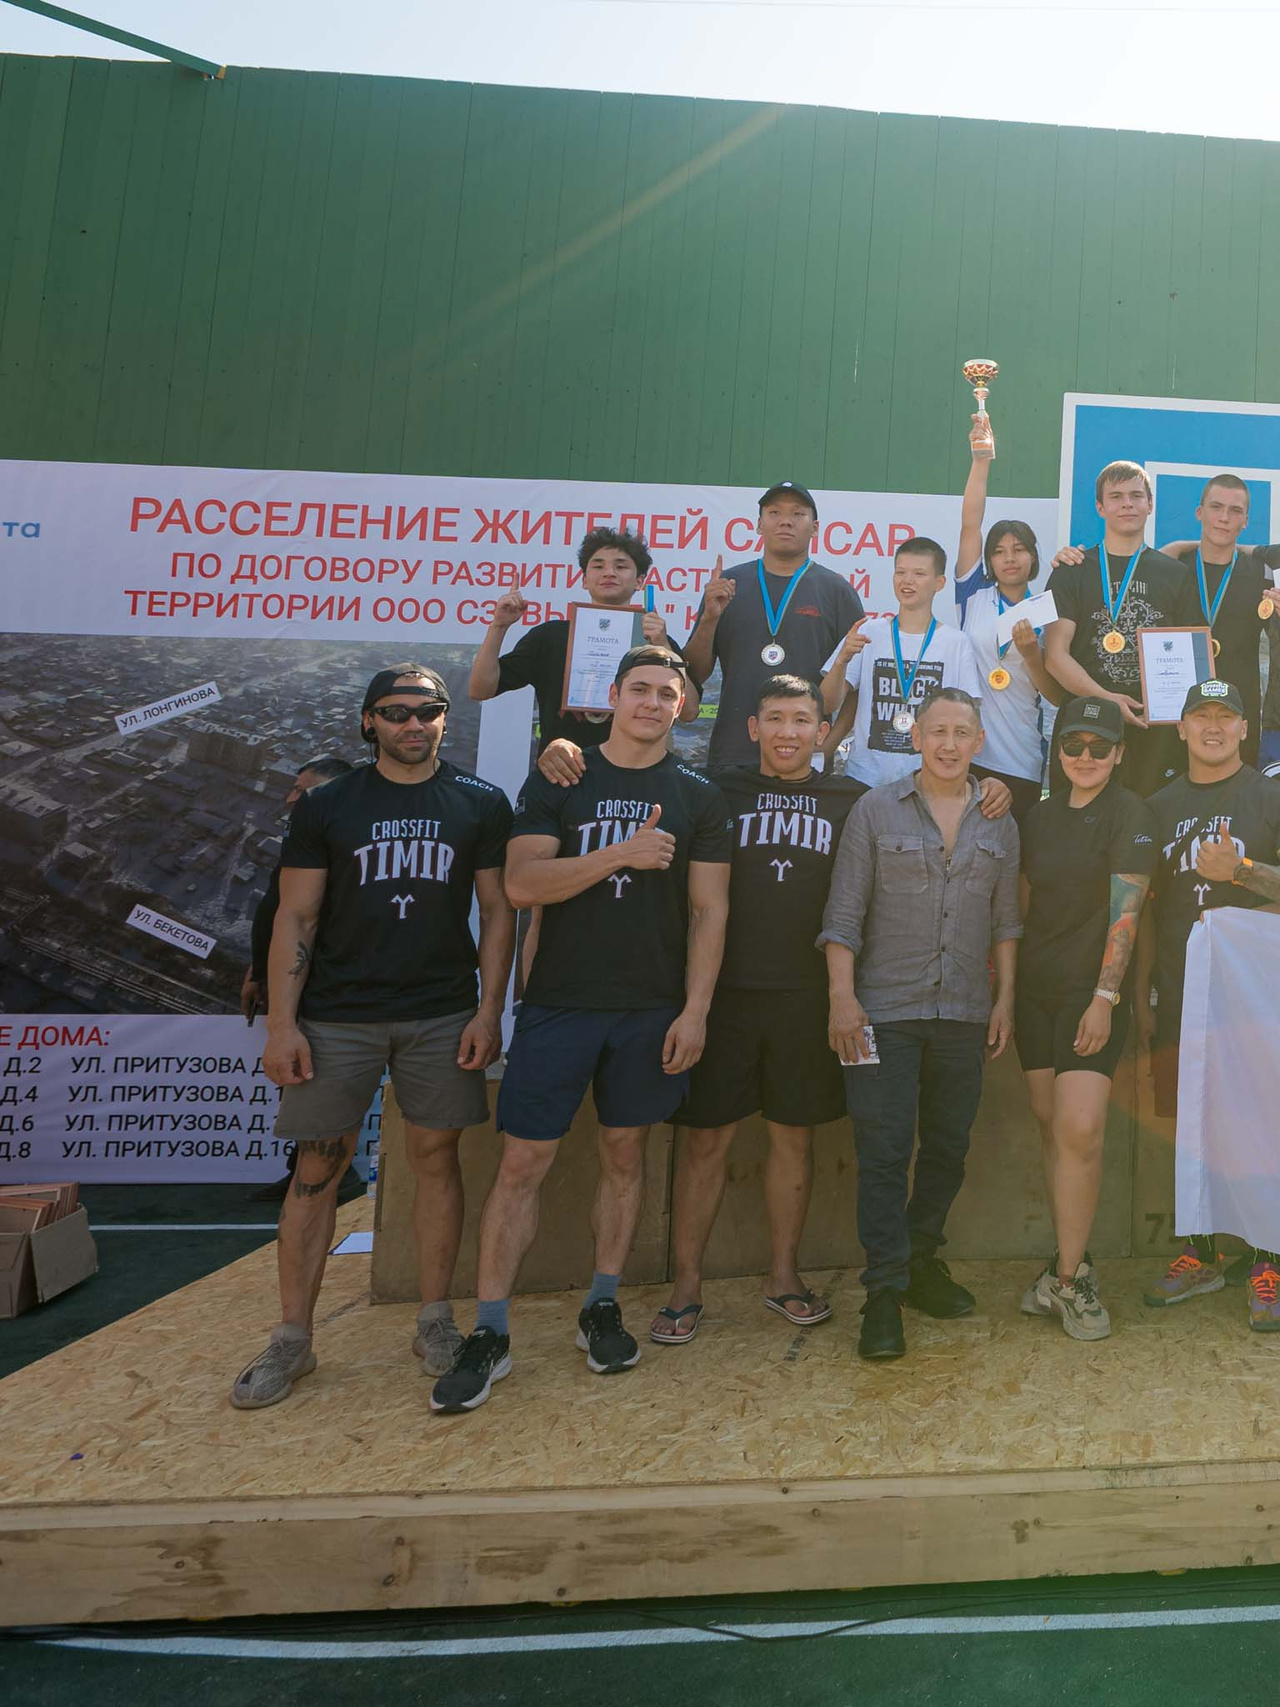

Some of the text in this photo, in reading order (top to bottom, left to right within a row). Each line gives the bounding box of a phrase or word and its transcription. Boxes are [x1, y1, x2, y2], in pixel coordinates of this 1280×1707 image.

[130, 497, 460, 542] РАССЕЛЕНИЕ
[171, 552, 583, 588] ПО ДОГОВОРУ РАЗВИТИ
[124, 590, 361, 621] ТЕРРИТОРИИ
[372, 596, 446, 624] ООО
[120, 687, 216, 728] УЛ. ЛОНГИНОВА
[455, 775, 494, 792] COACH
[676, 763, 710, 785] COACH
[757, 793, 817, 815] CROSSFIT
[372, 818, 441, 841] CROSSFIT
[739, 811, 833, 855] TIMIR
[354, 840, 455, 886] TIMIR
[134, 909, 209, 951] УЛ. БЕКЕТОВА
[17, 1026, 110, 1051] ДОМА:
[3, 1057, 42, 1077] Д.2
[71, 1057, 106, 1073] УЛ.
[113, 1057, 246, 1073] ПРИТУЗОВА
[0, 1085, 284, 1106] Д.4 УЛ. ПРИТУЗОВА Д.1
[0, 1115, 34, 1135] Д.6
[65, 1115, 100, 1131] УЛ.
[107, 1114, 242, 1131] ПРИТУЗОВА
[0, 1141, 31, 1162] Д.8
[62, 1141, 97, 1158] УЛ.
[104, 1140, 240, 1158] ПРИТУЗОВА
